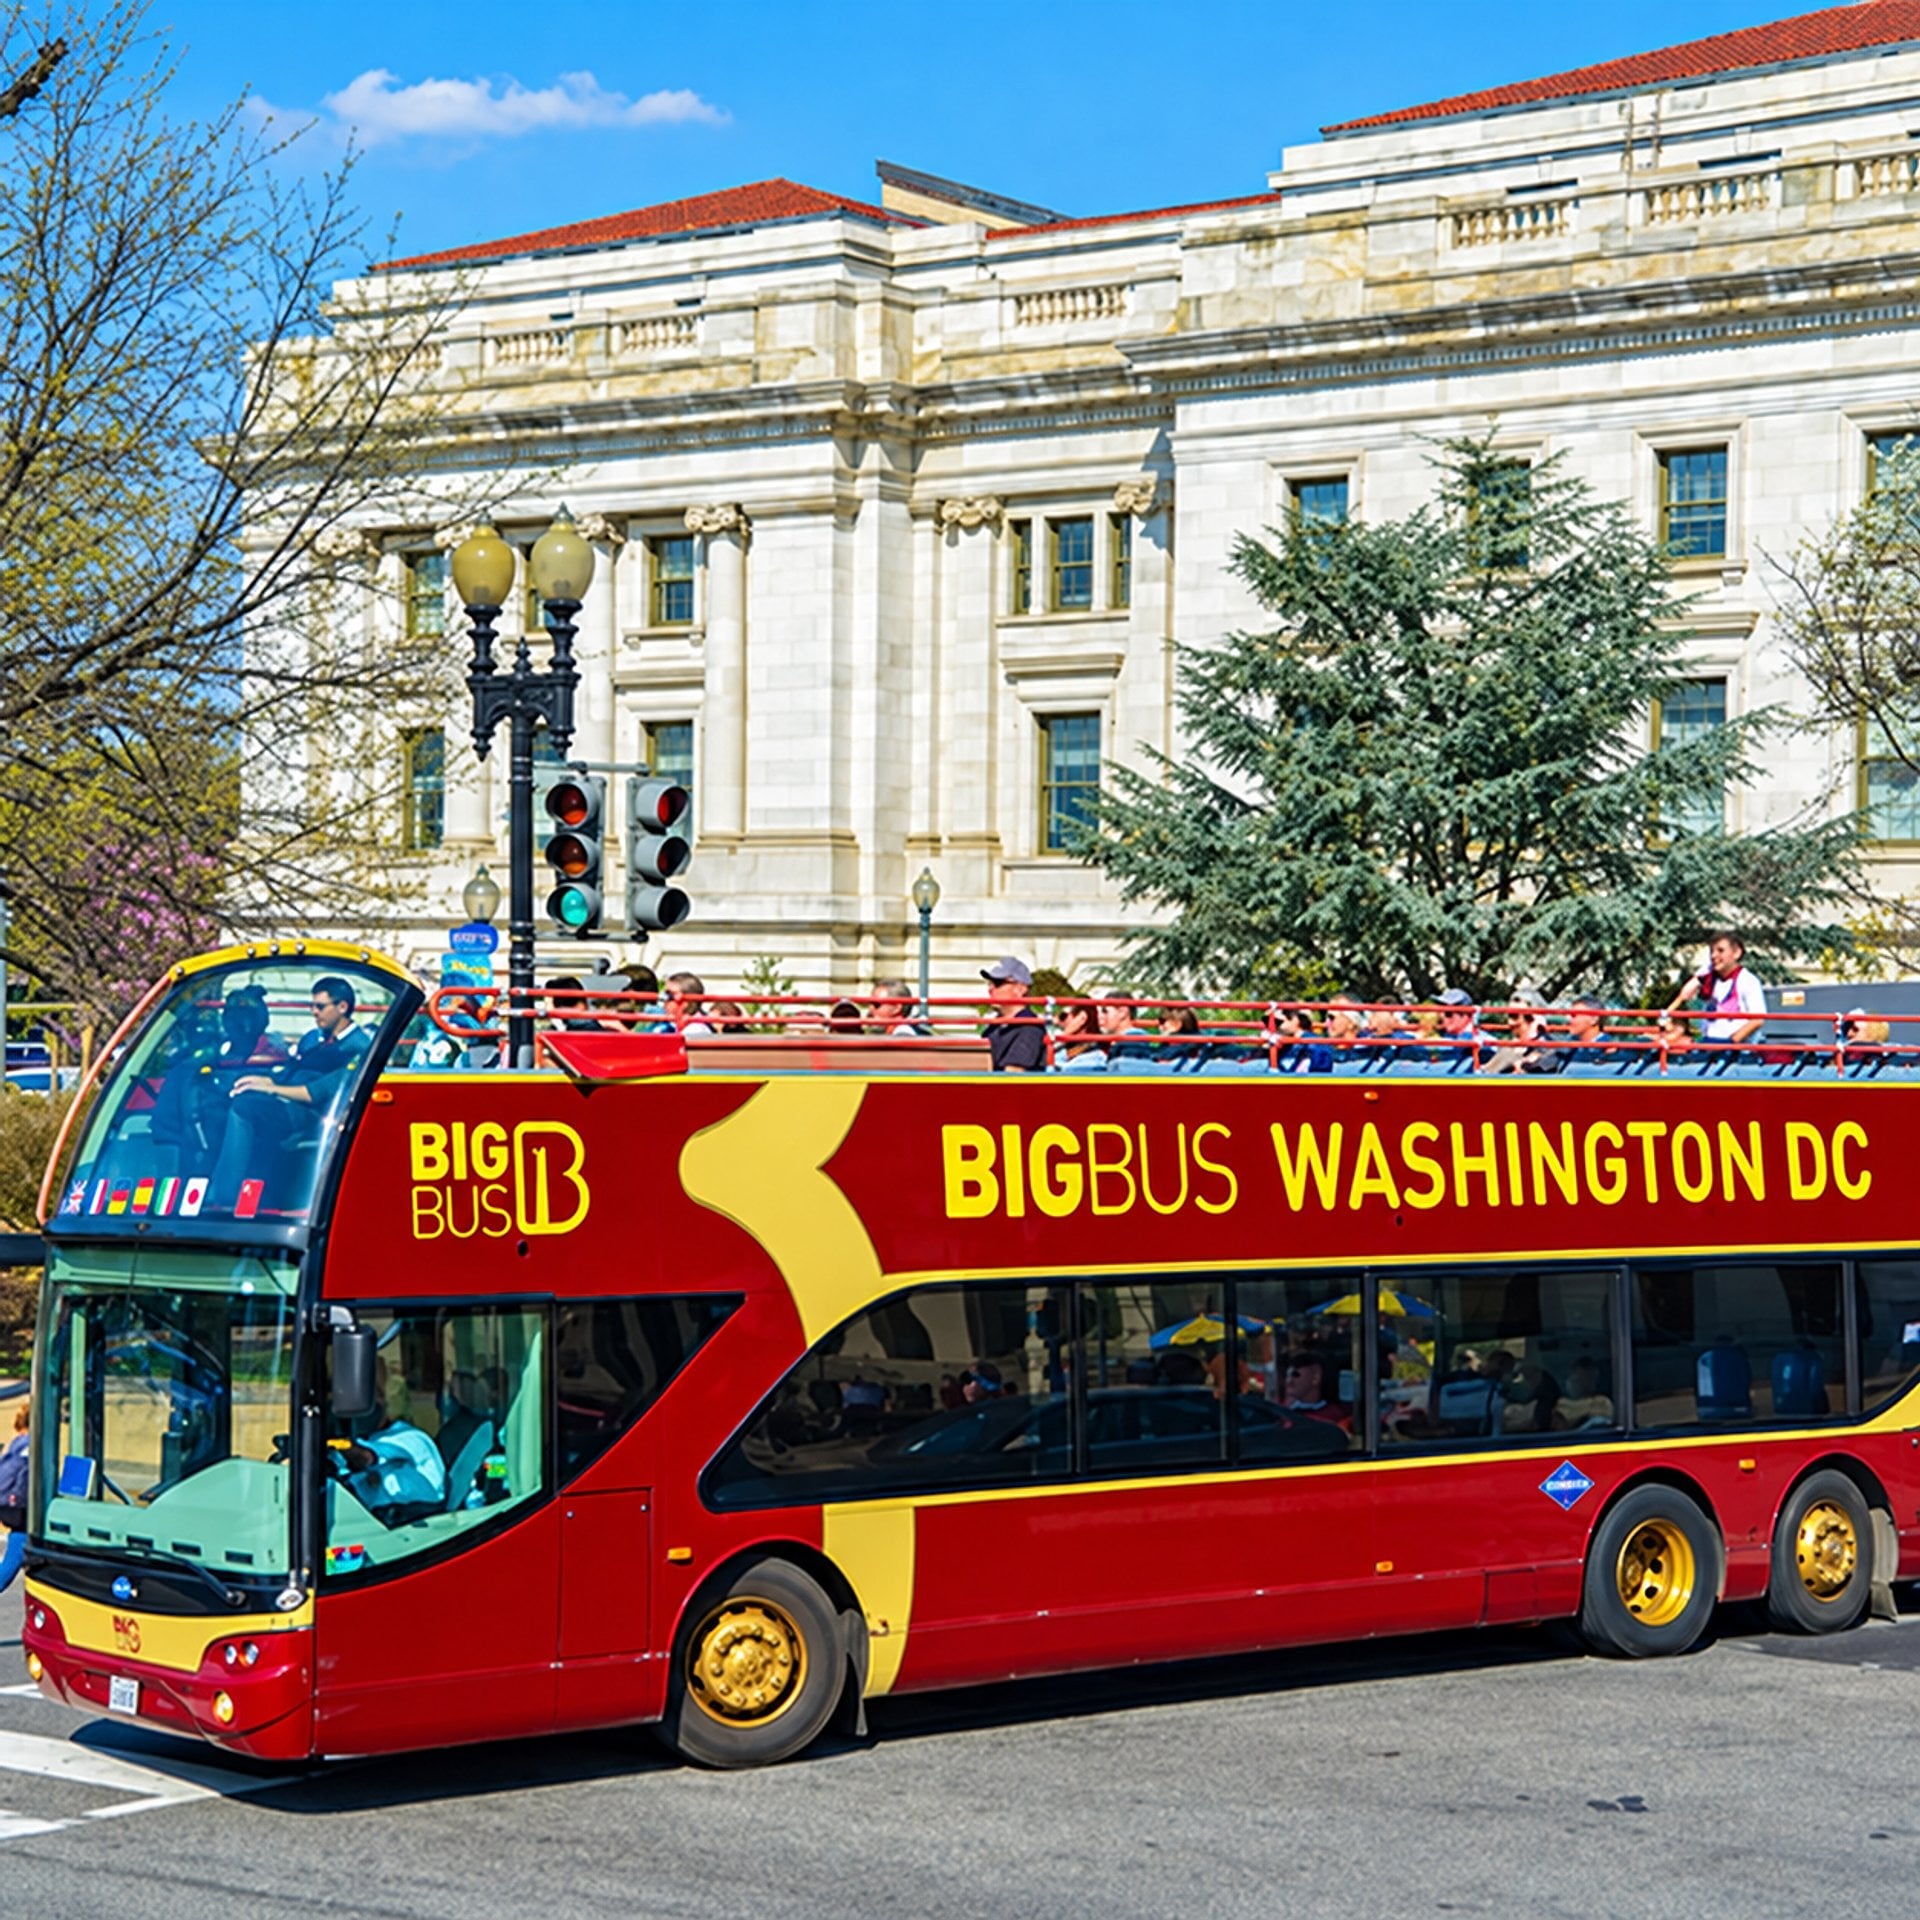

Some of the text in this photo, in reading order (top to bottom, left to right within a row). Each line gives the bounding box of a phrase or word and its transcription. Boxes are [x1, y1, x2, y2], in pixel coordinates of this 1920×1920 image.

[409, 1121, 509, 1181] BIG
[1270, 1120, 1766, 1212] WASHINGTON
[1785, 1121, 1873, 1200] DC
[411, 1184, 512, 1240] BUS
